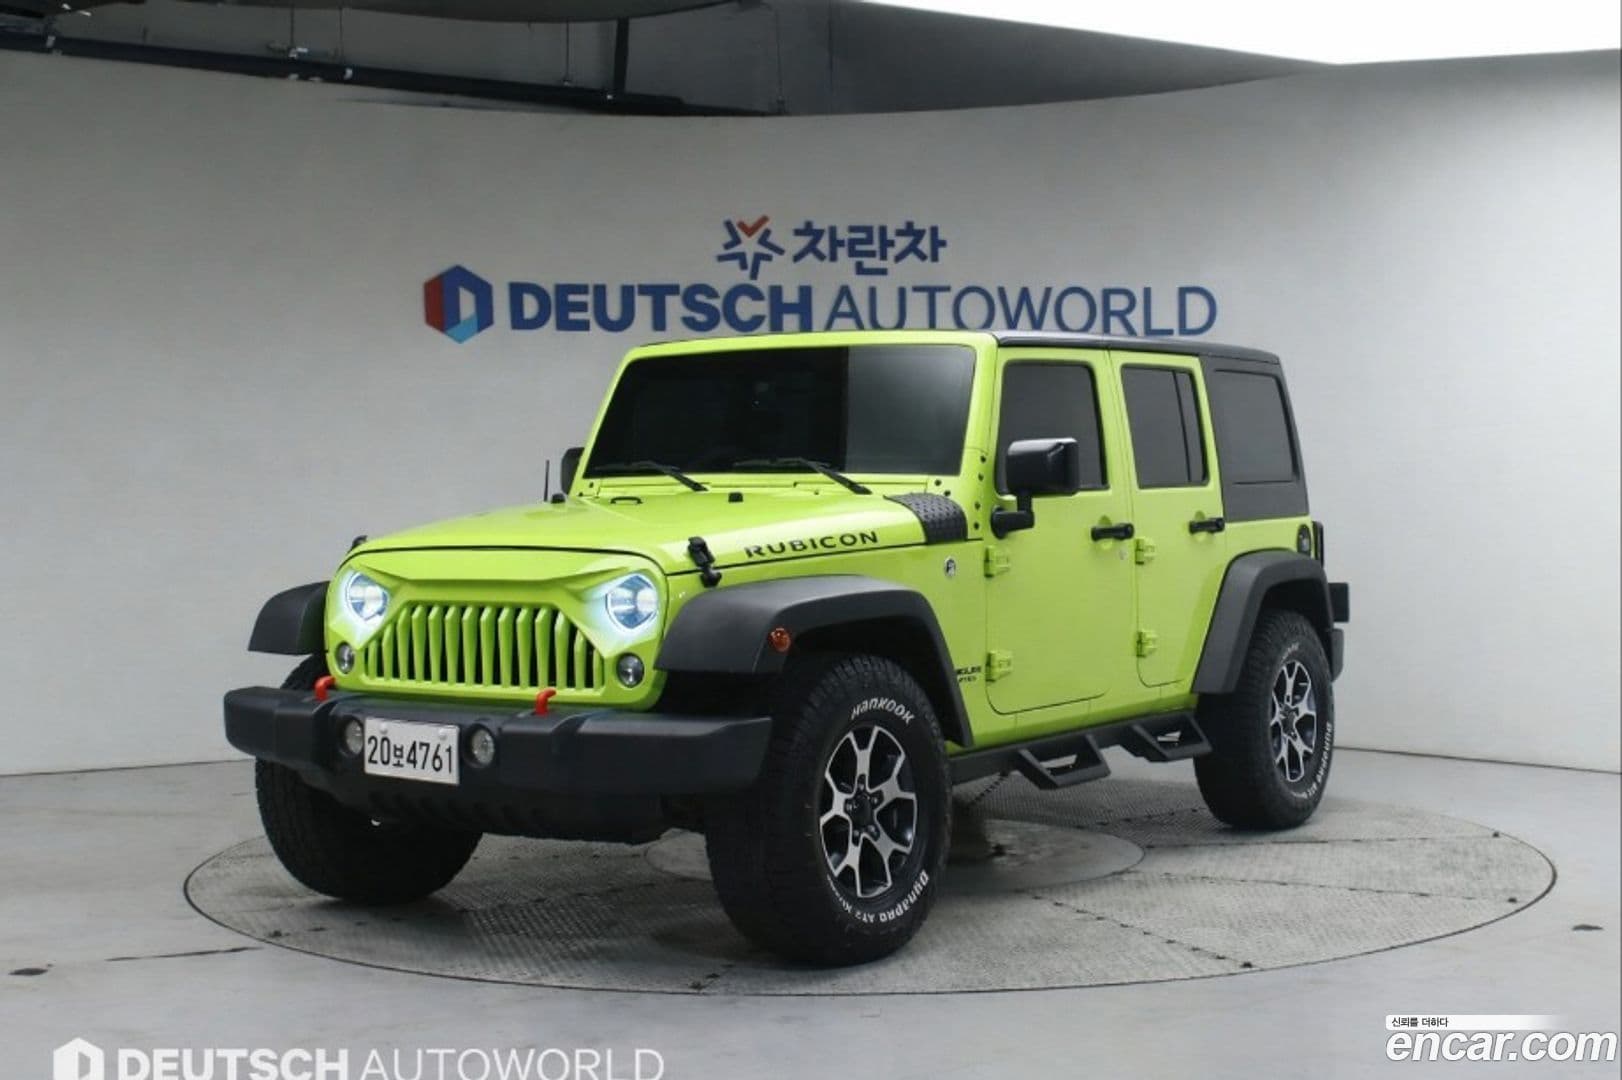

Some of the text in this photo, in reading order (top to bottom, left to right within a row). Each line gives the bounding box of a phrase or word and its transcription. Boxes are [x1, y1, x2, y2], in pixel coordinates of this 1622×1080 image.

[793, 221, 947, 276] 차란차
[508, 281, 1218, 336] DEUTSCH AUTOWORLD
[744, 531, 879, 558] RUBICON
[367, 735, 453, 774] 20보4761
